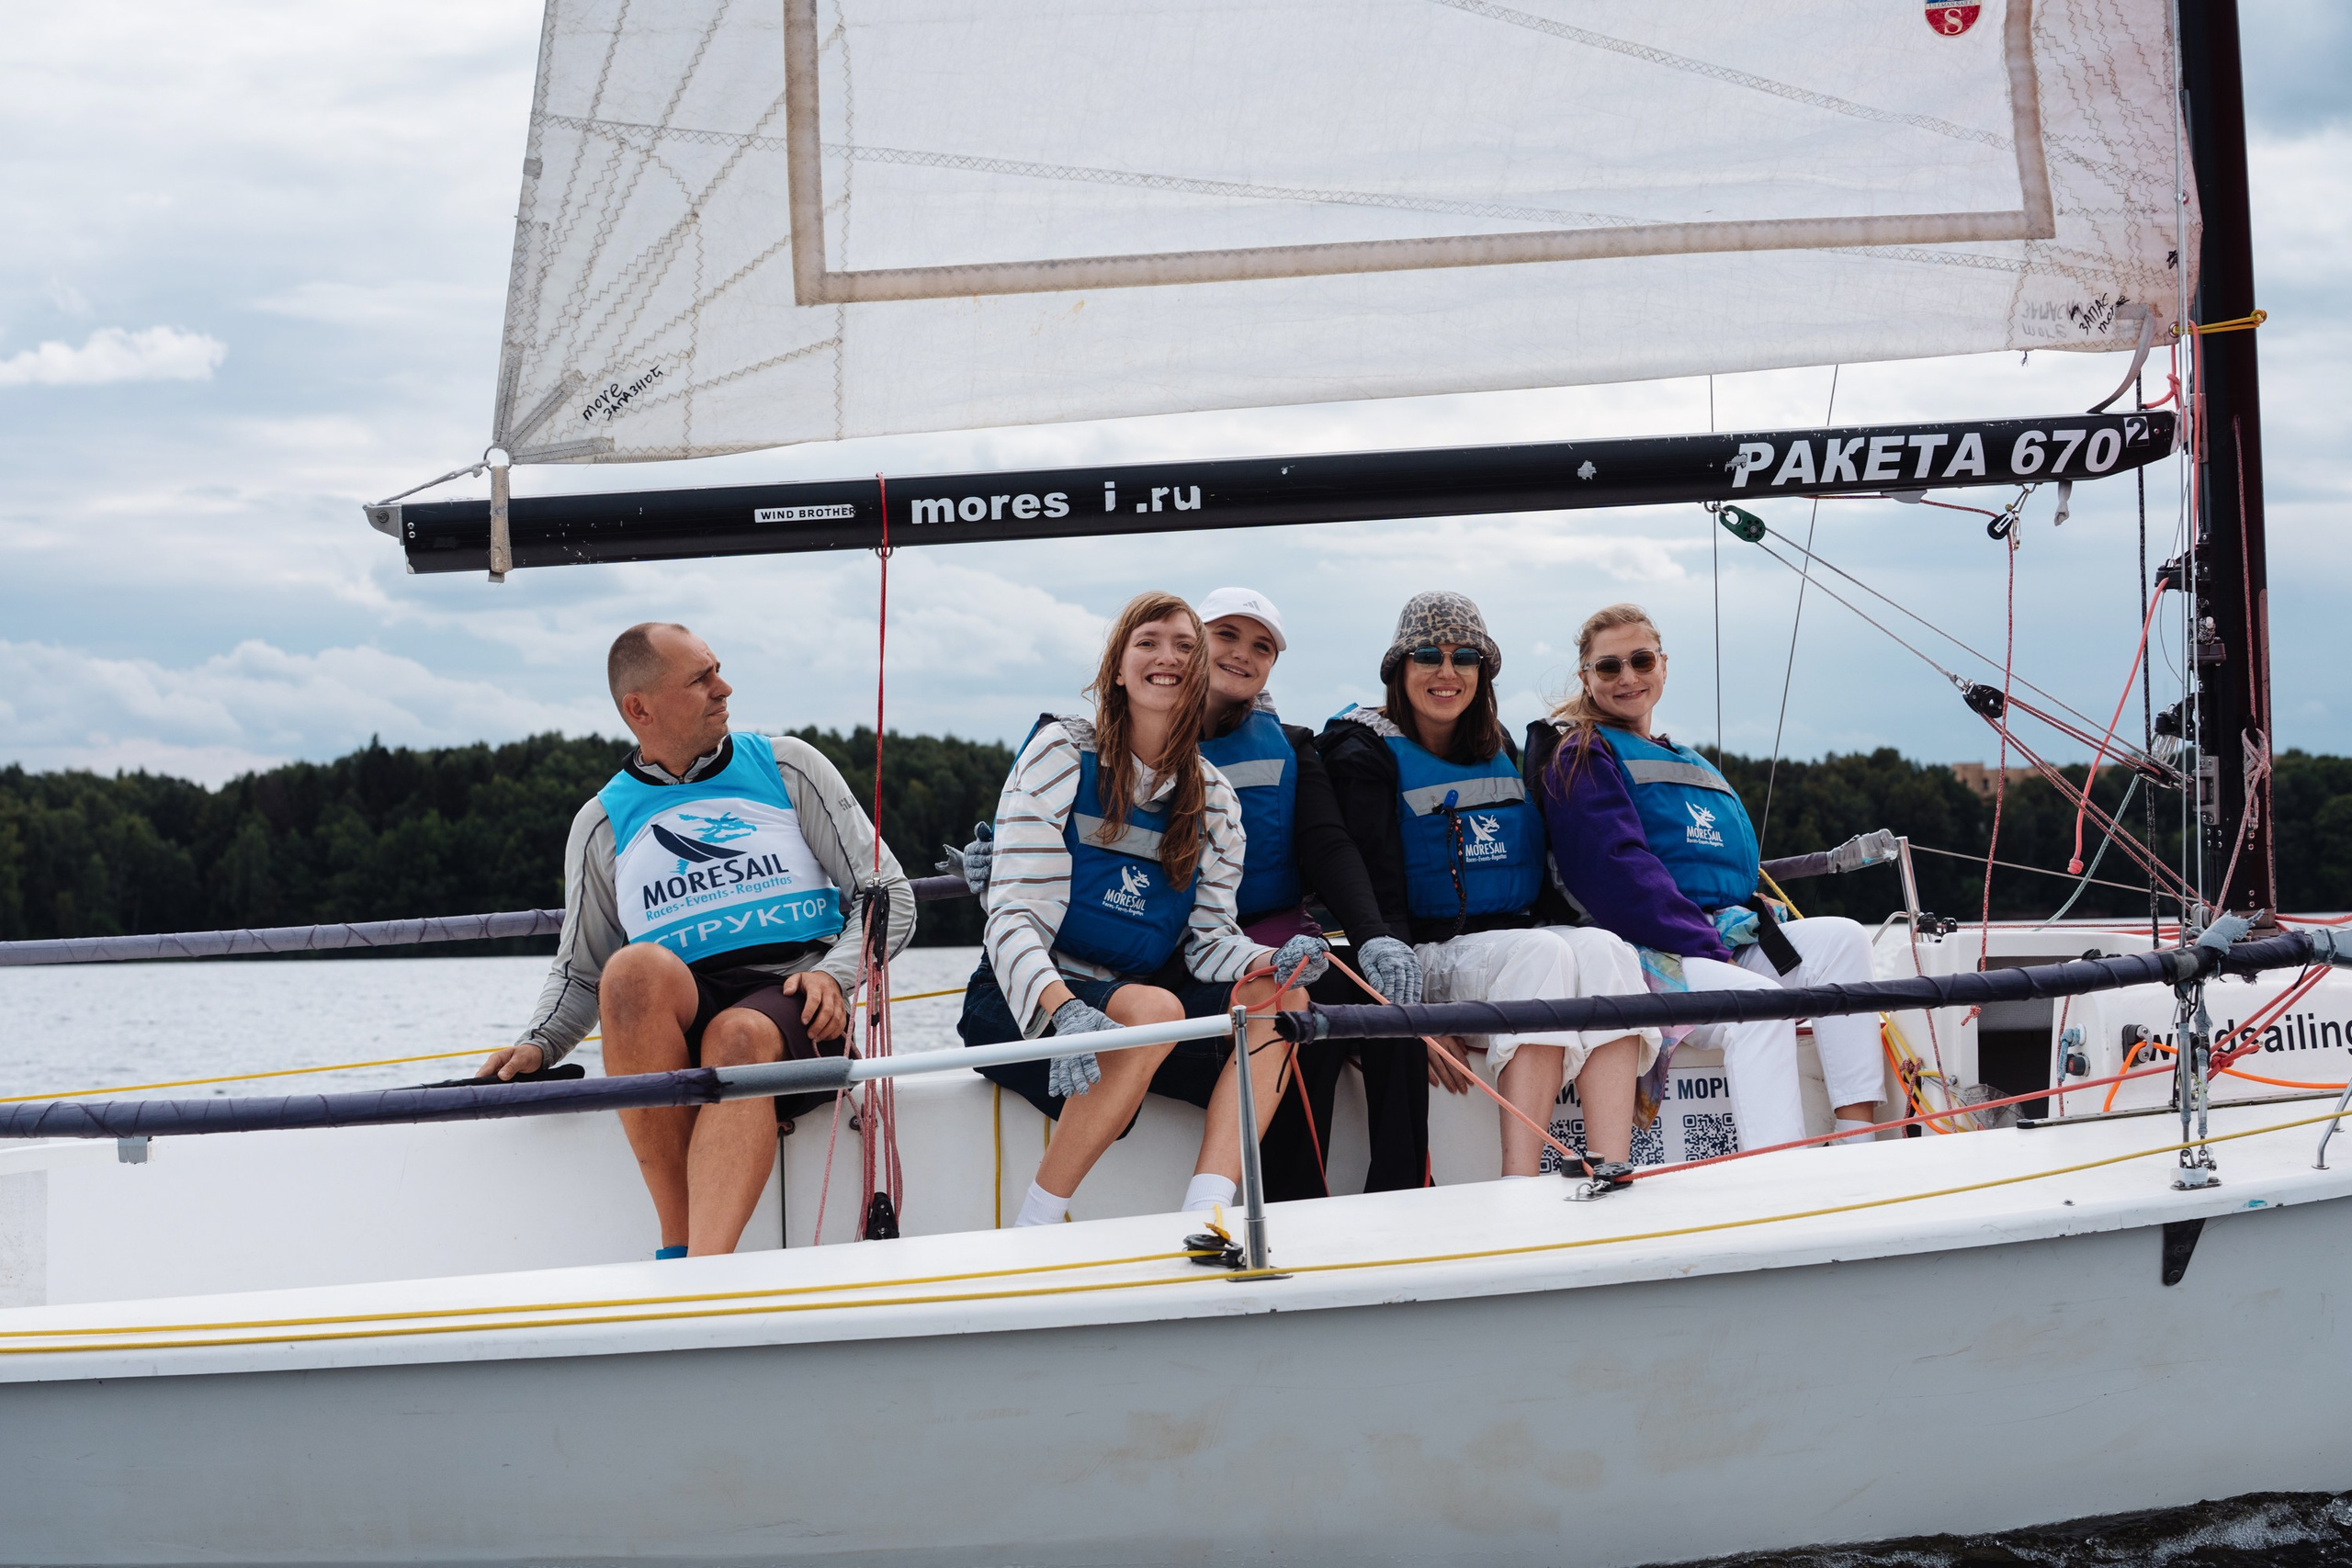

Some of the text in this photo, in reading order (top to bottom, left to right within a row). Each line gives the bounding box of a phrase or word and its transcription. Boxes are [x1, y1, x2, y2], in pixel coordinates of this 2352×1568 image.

[1944, 8, 1963, 35] S
[1731, 416, 2148, 488] РАКЕТА 670 2
[761, 507, 855, 520] WIND BROTHER
[911, 491, 1069, 524] mores
[1687, 825, 1724, 842] MORESAIL
[1465, 842, 1507, 856] MORESAIL
[643, 853, 789, 910] MORESAIL
[1103, 888, 1147, 911] MORESAIL
